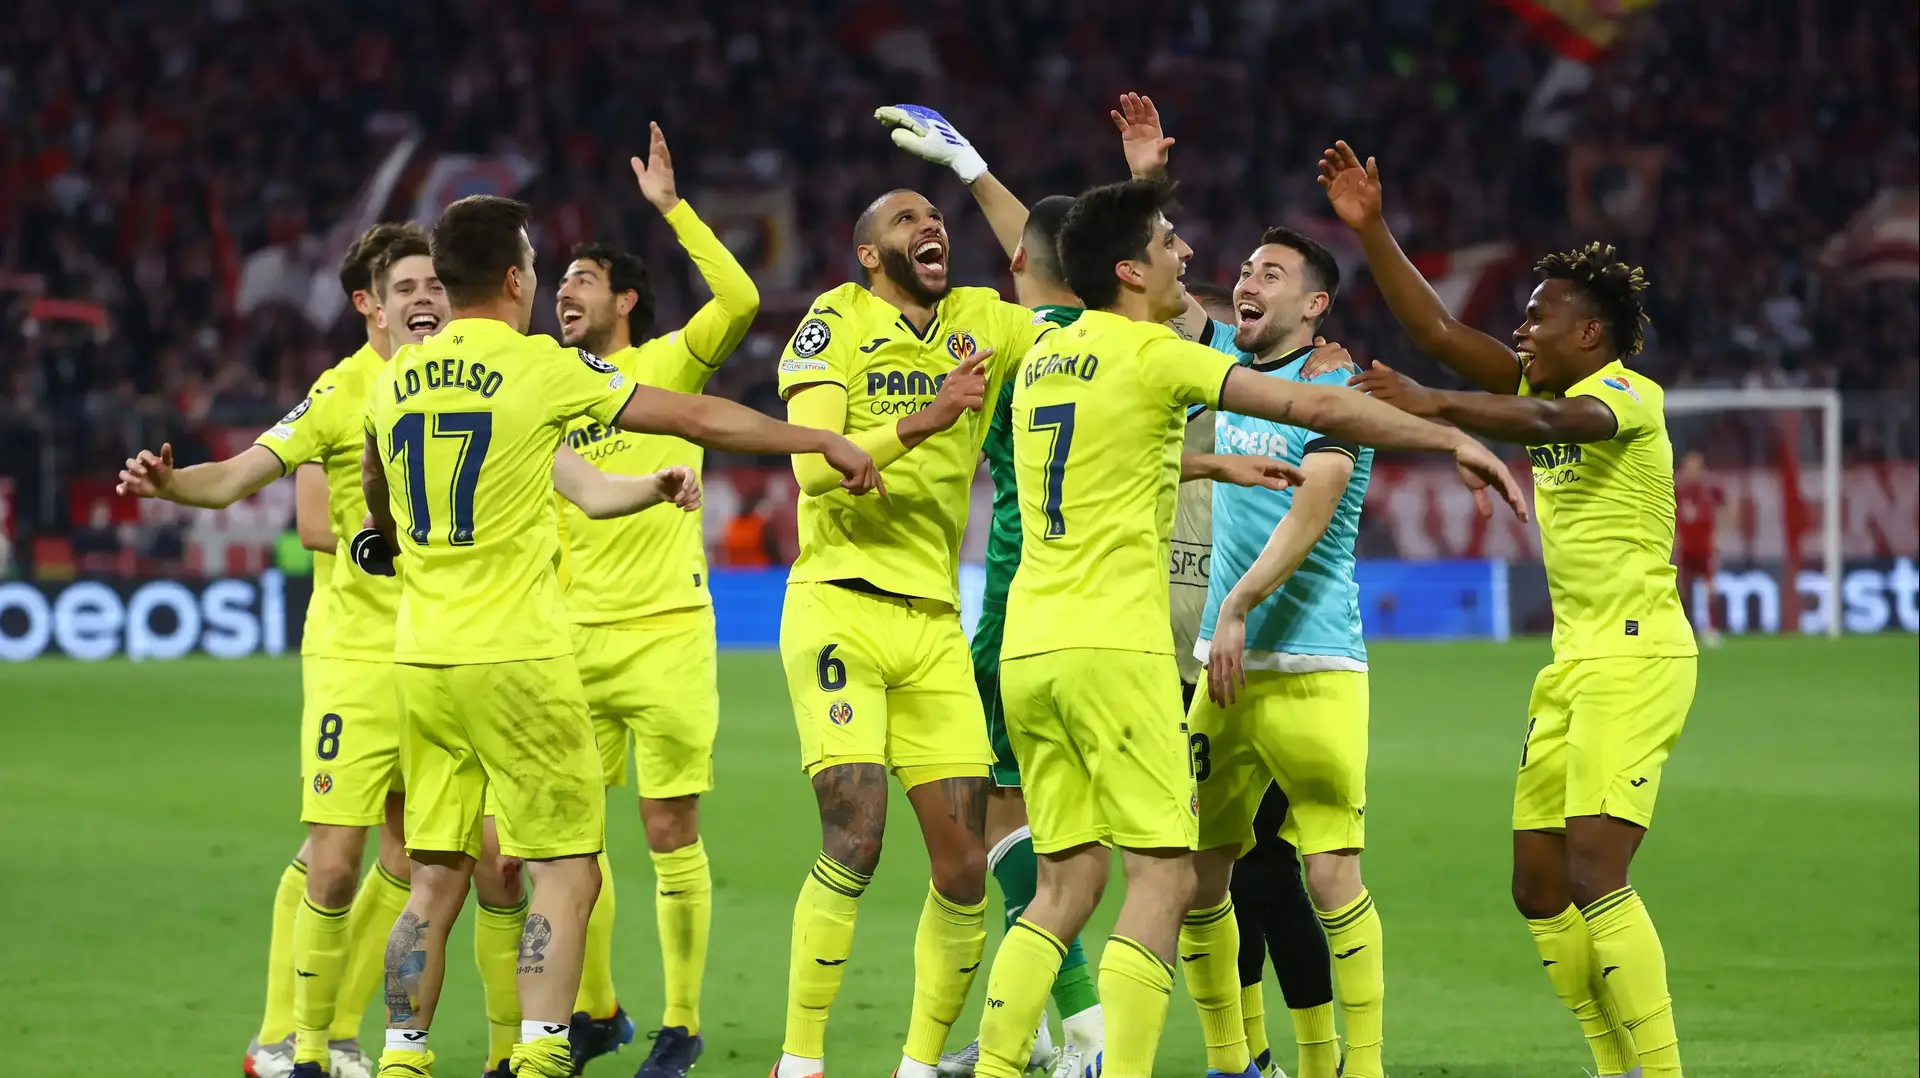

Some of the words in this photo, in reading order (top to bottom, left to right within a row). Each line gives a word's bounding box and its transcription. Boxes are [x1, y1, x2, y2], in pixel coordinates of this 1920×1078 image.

[394, 369, 420, 404] LO
[425, 359, 504, 399] CELSO
[782, 362, 827, 372] FOUNDATION
[388, 411, 492, 546] 17
[1028, 402, 1076, 540] 7
[816, 644, 847, 692] 6
[316, 713, 343, 760] 8
